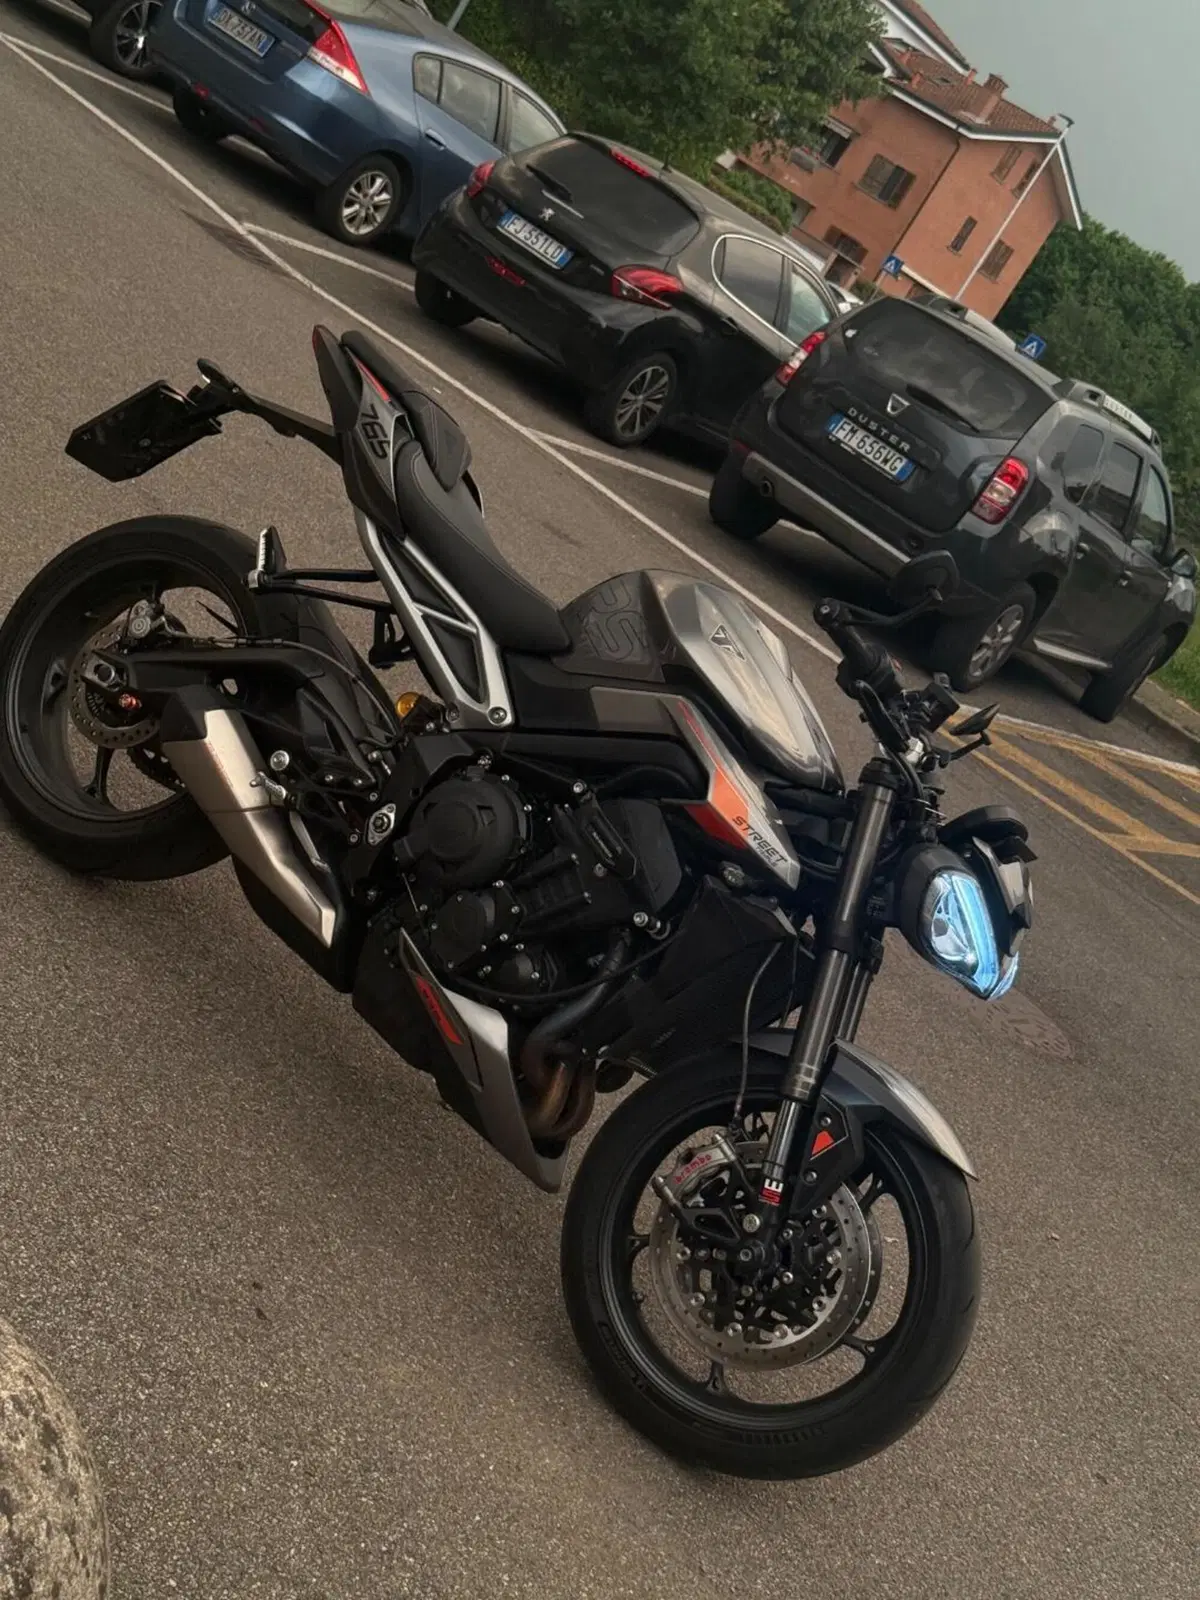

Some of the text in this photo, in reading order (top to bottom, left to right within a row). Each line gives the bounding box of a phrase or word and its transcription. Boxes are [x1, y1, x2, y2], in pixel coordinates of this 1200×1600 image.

[361, 403, 391, 459] 765
[847, 407, 911, 452] DUSTER
[732, 815, 788, 864] STREET
